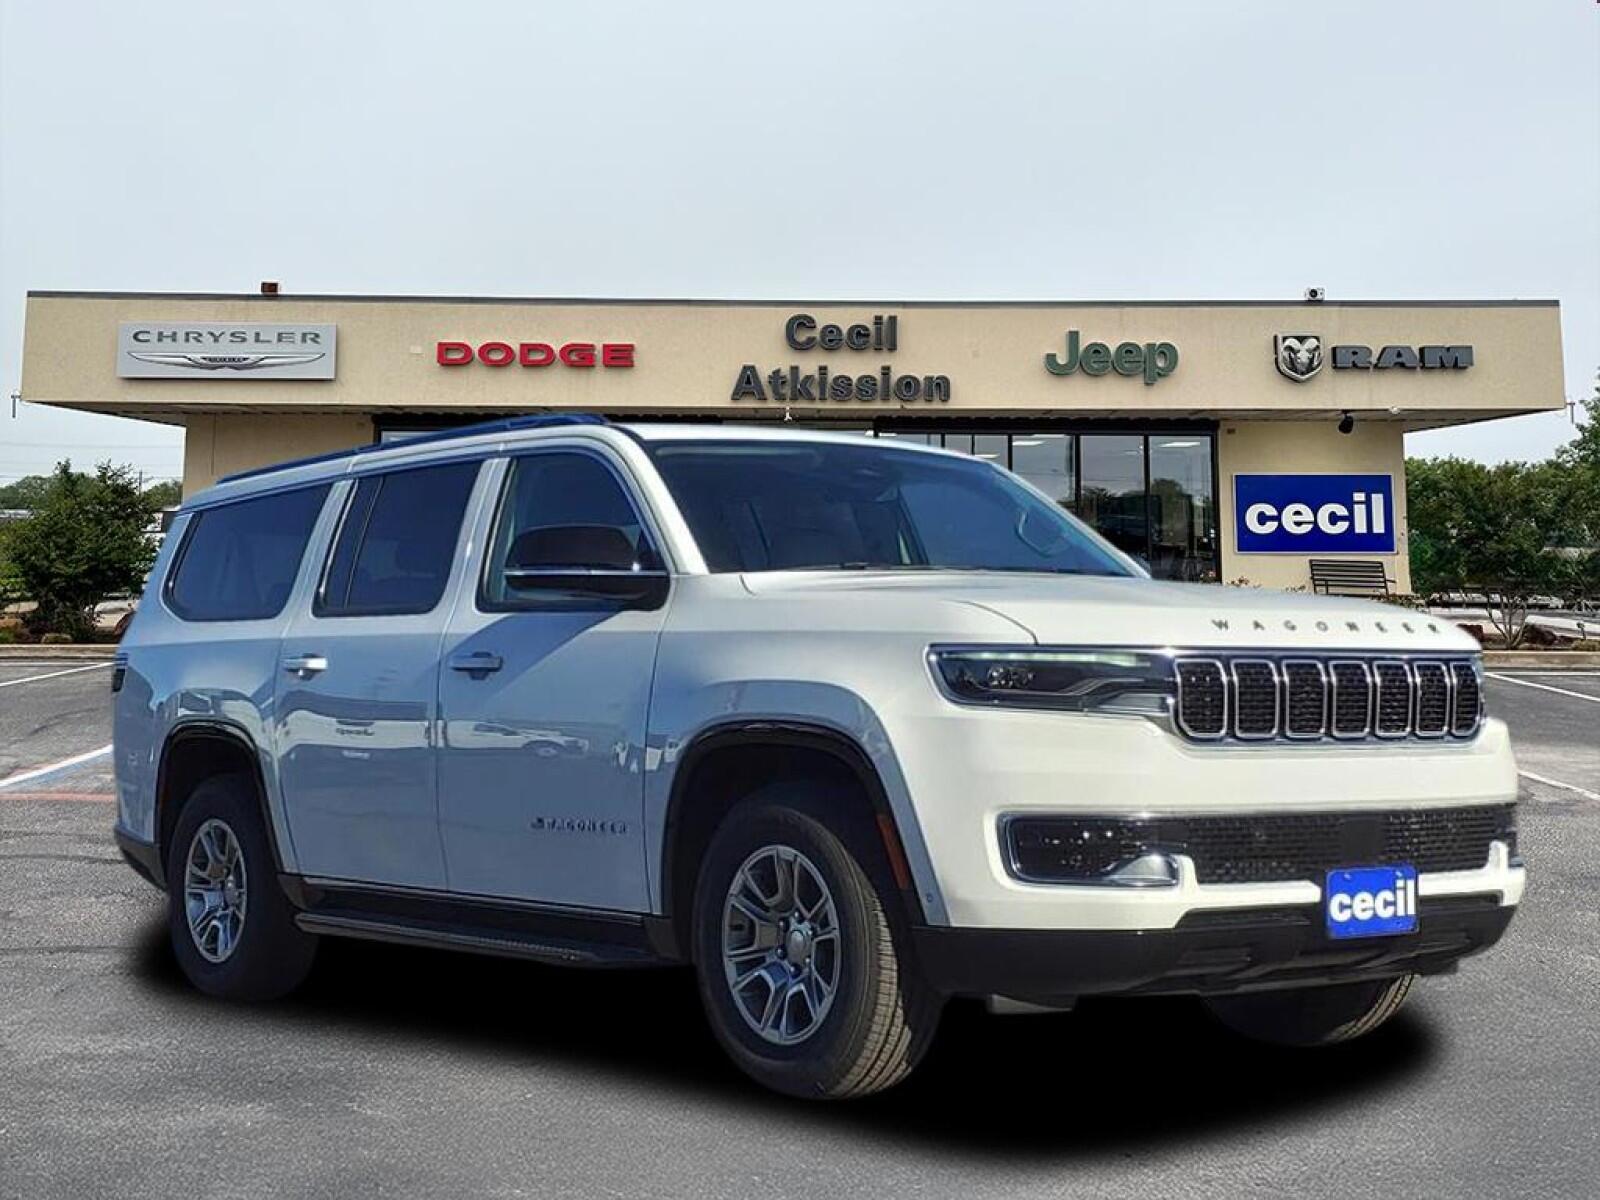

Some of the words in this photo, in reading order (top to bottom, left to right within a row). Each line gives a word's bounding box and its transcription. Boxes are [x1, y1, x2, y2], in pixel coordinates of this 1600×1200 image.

[132, 329, 322, 346] CHRYSLER
[785, 313, 898, 351] Cecil
[436, 341, 635, 368] DODGE
[1045, 330, 1179, 386] Jeep
[1331, 344, 1474, 370] RAM
[731, 364, 951, 401] Atkission
[1245, 491, 1385, 534] cecil
[1212, 619, 1439, 633] WAGONEER
[1329, 879, 1416, 922] cecil
